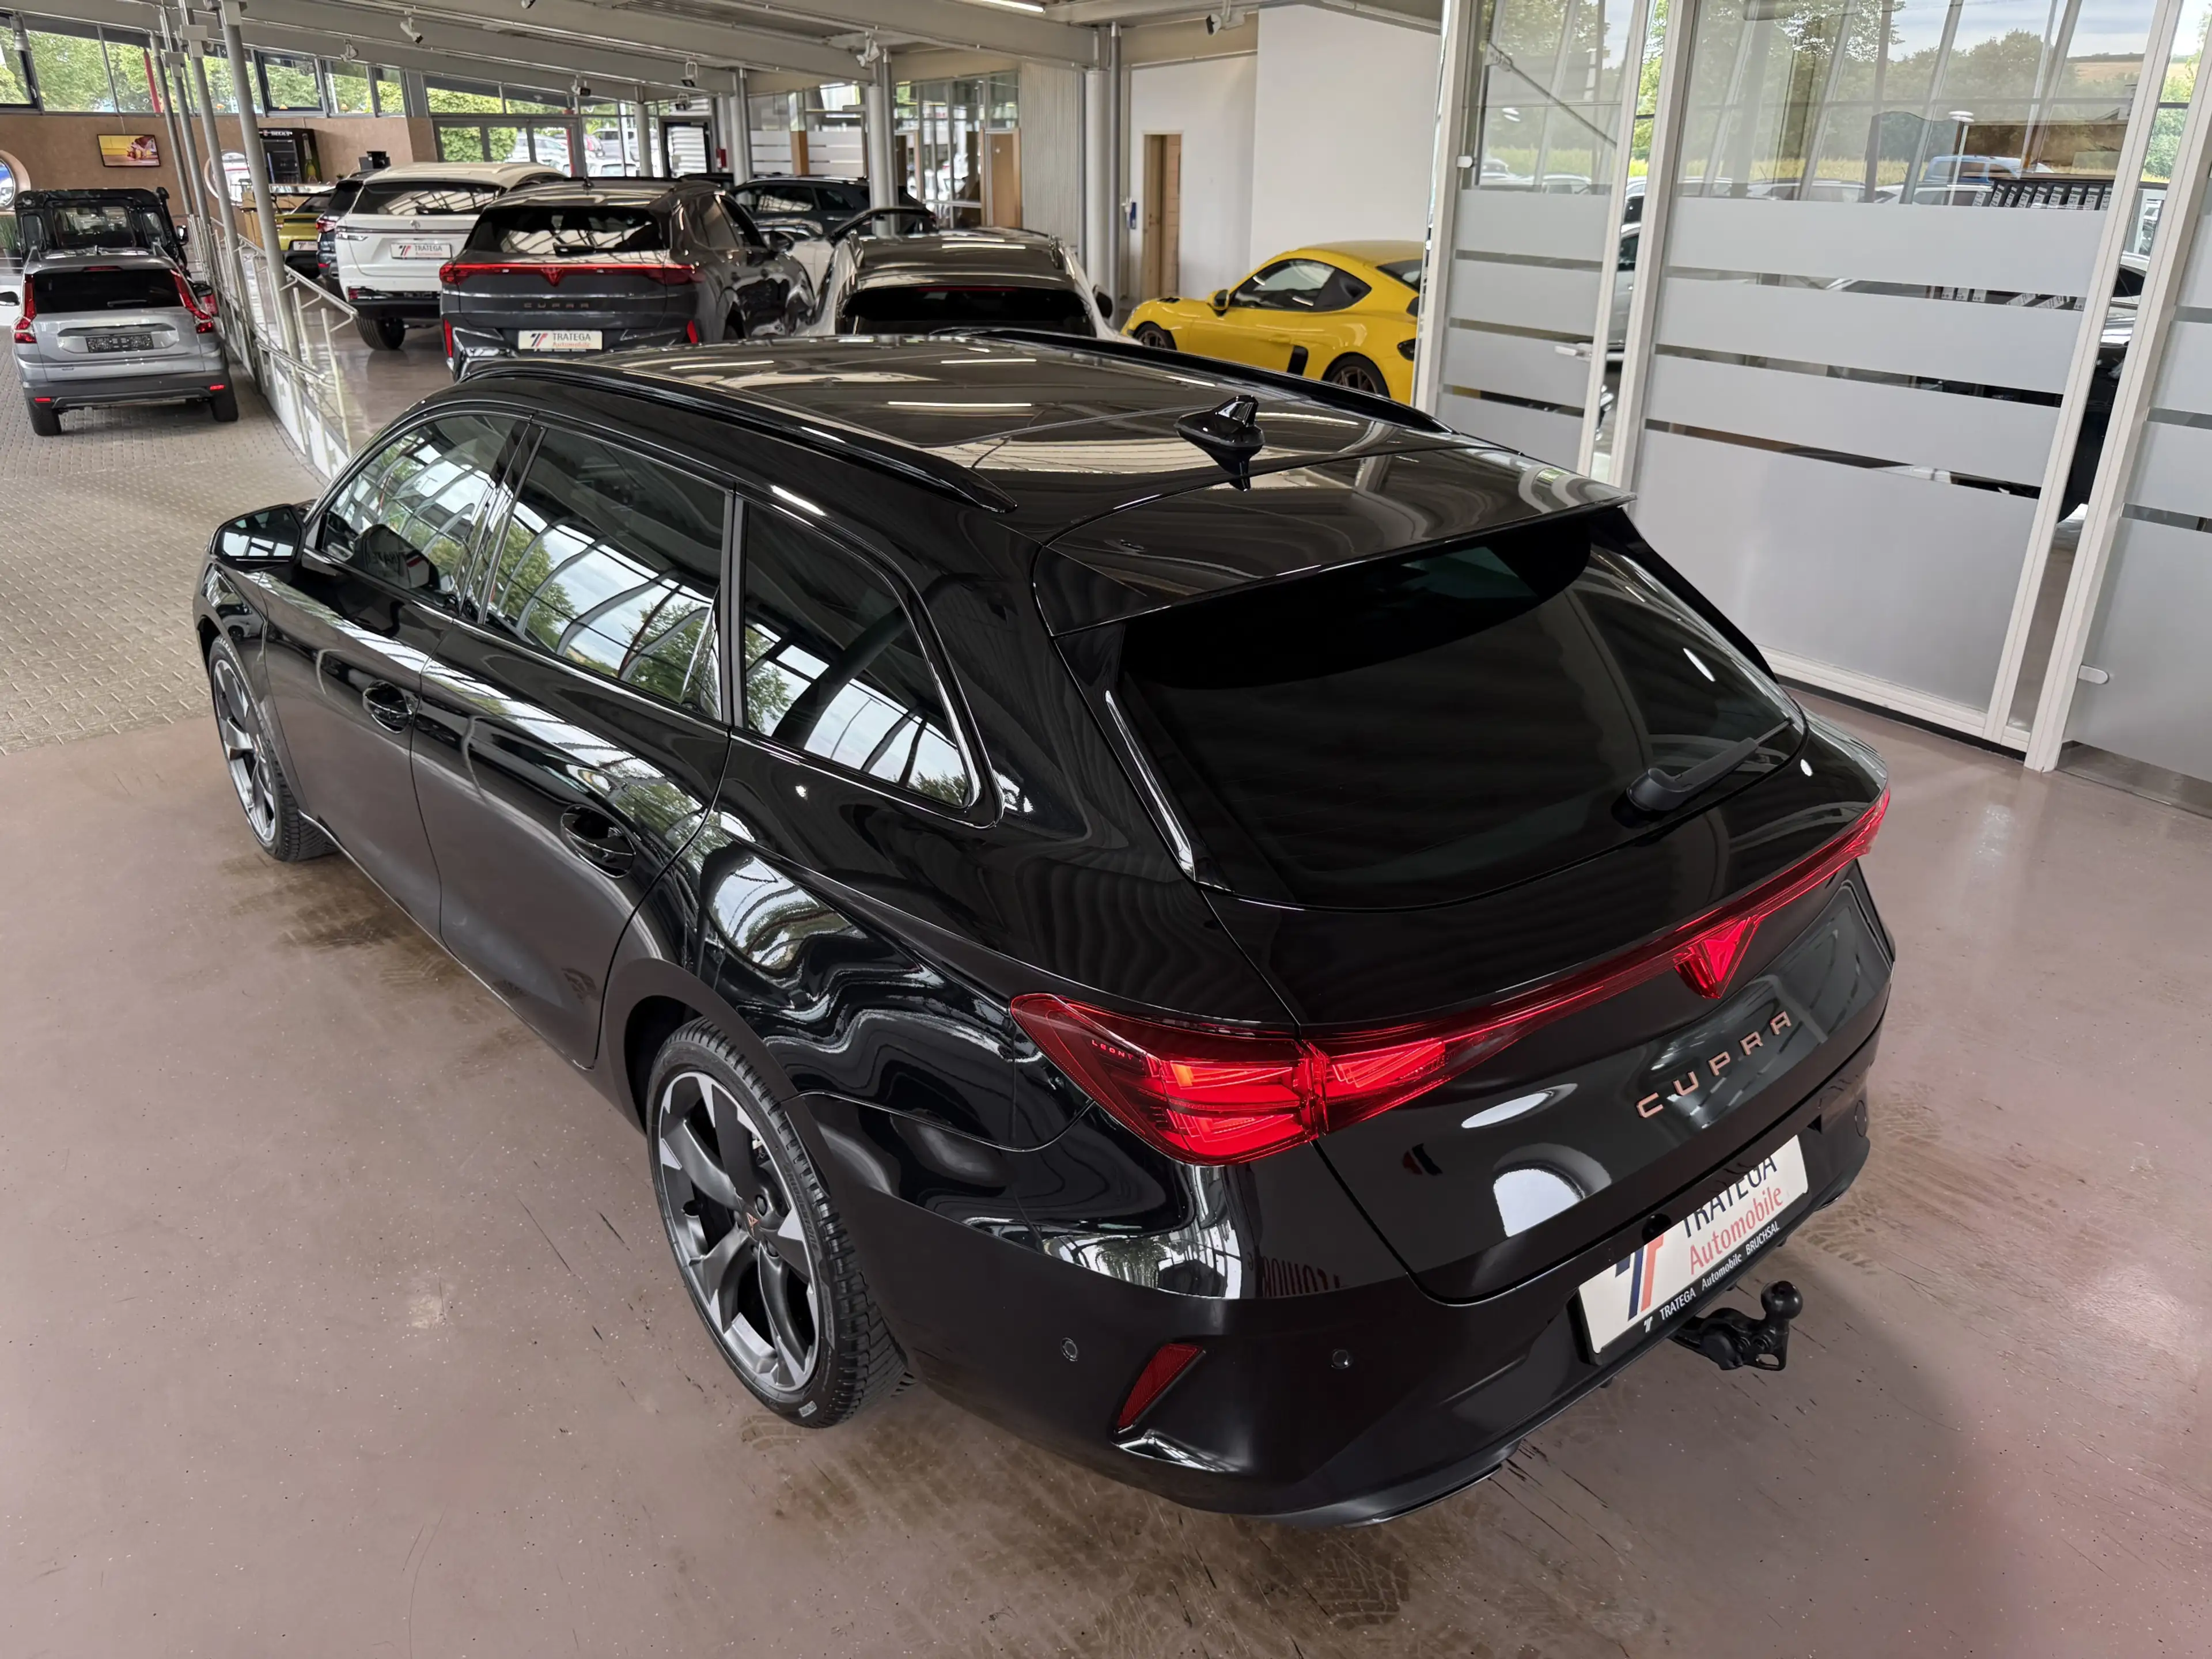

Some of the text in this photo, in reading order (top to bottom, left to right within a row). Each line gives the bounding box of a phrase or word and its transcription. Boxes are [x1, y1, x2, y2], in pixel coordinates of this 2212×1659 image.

[553, 333, 591, 341] TRATEGA
[1637, 1011, 1791, 1118] CUPRA
[1660, 1221, 1779, 1320] TRATEGA Automobile BRUCHSAL
[1690, 1187, 1783, 1275] Automobile
